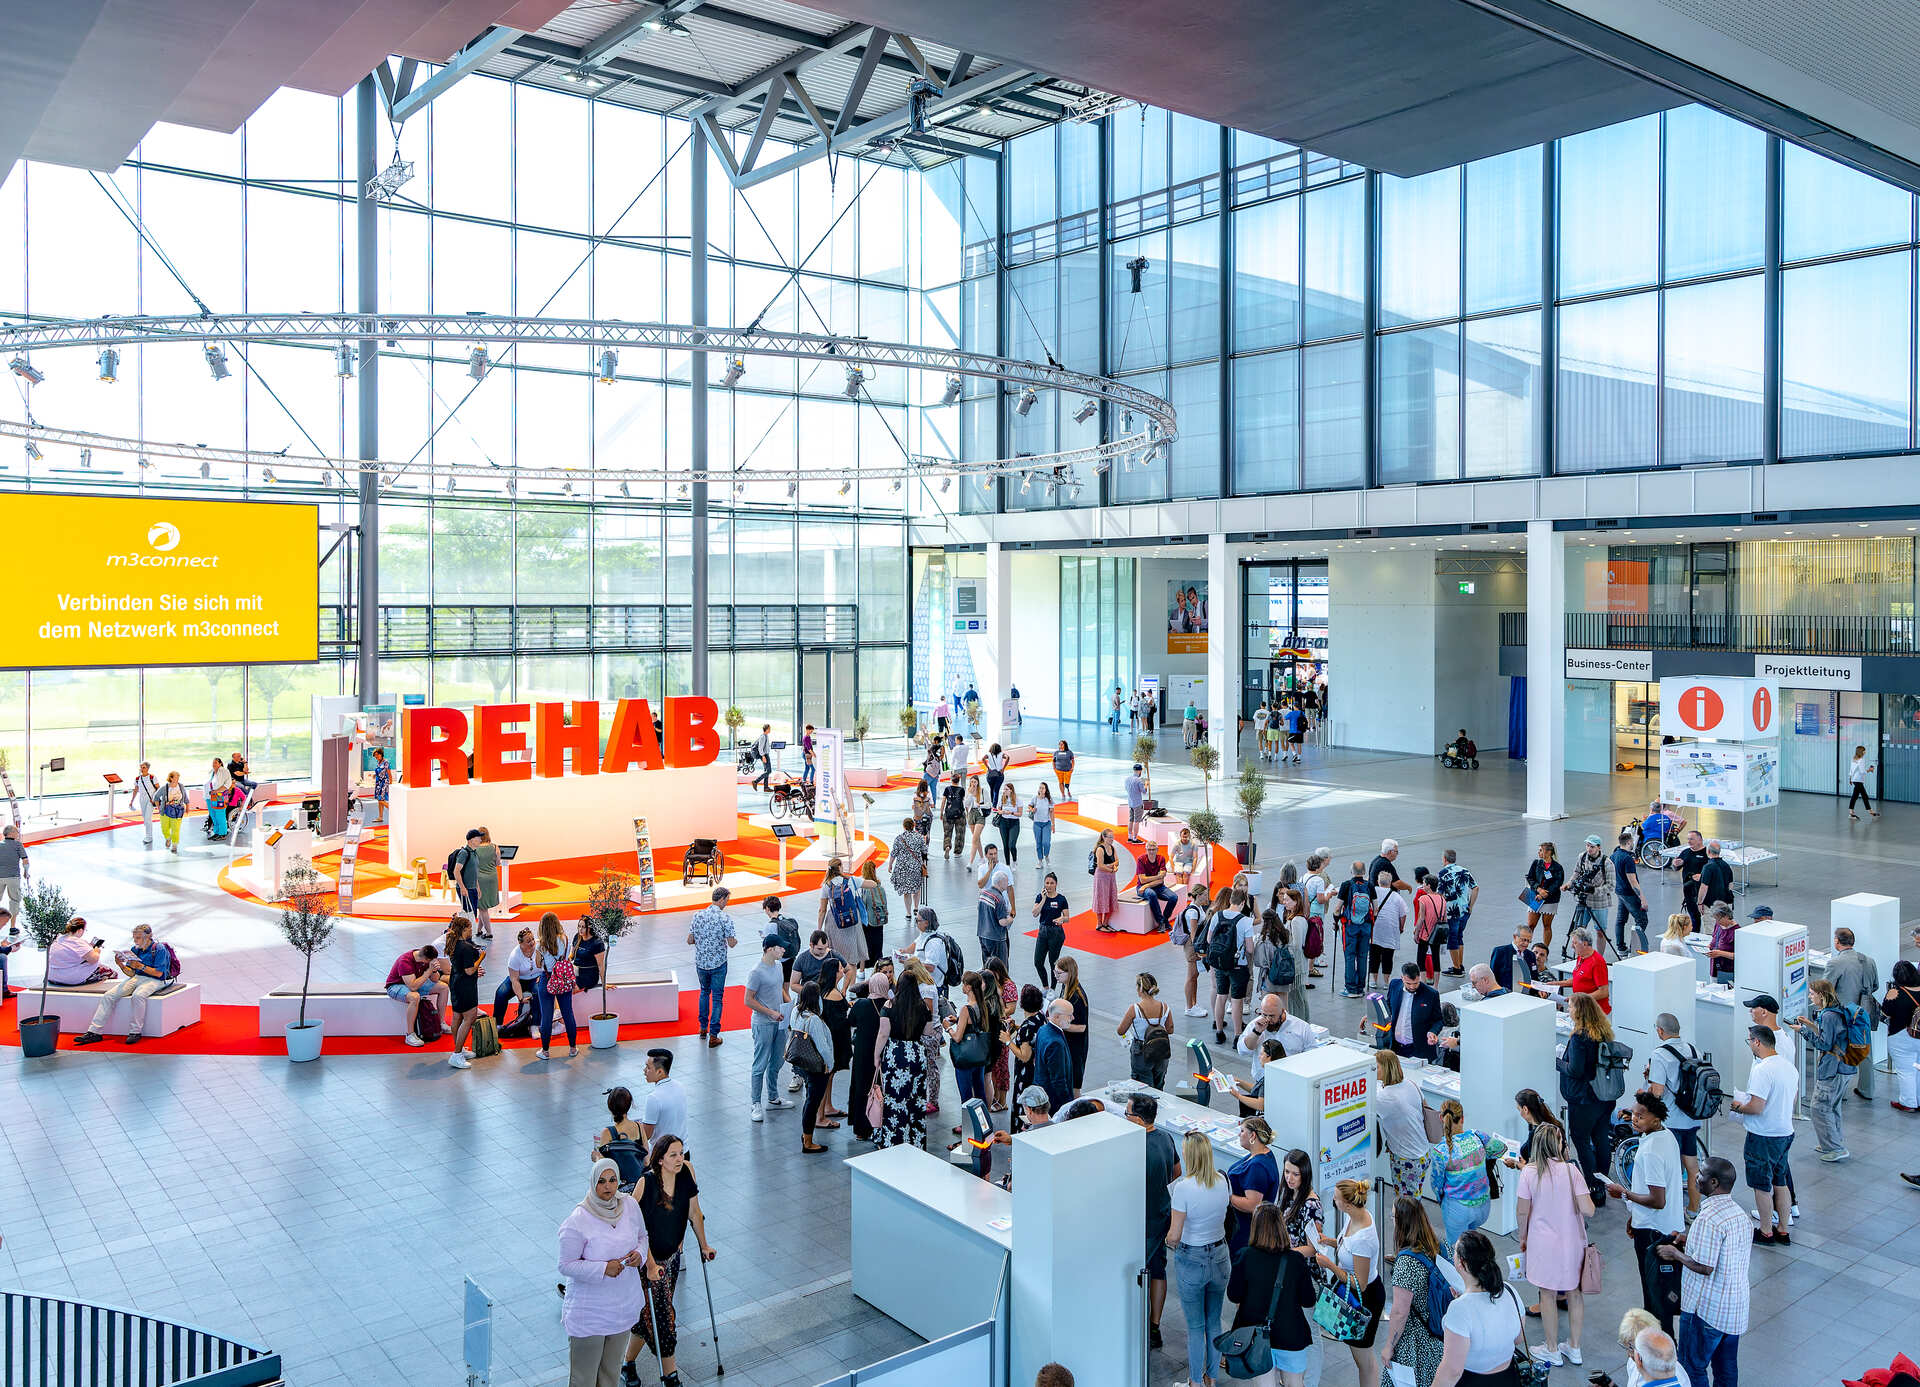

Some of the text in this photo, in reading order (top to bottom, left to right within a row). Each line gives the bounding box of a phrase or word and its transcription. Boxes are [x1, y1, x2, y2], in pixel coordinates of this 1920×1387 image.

[106, 553, 219, 568] m3connect
[57, 594, 263, 611] Verbinden Sie sich mit
[39, 620, 280, 638] dem Netzwerk m3connect
[1567, 658, 1651, 671] Business-Center
[1764, 664, 1851, 680] Projektleitung
[401, 695, 721, 788] REHAB
[1785, 940, 1806, 957] REHAB
[1325, 1078, 1367, 1106] REHAB
[1354, 1158, 1367, 1170] 2023
